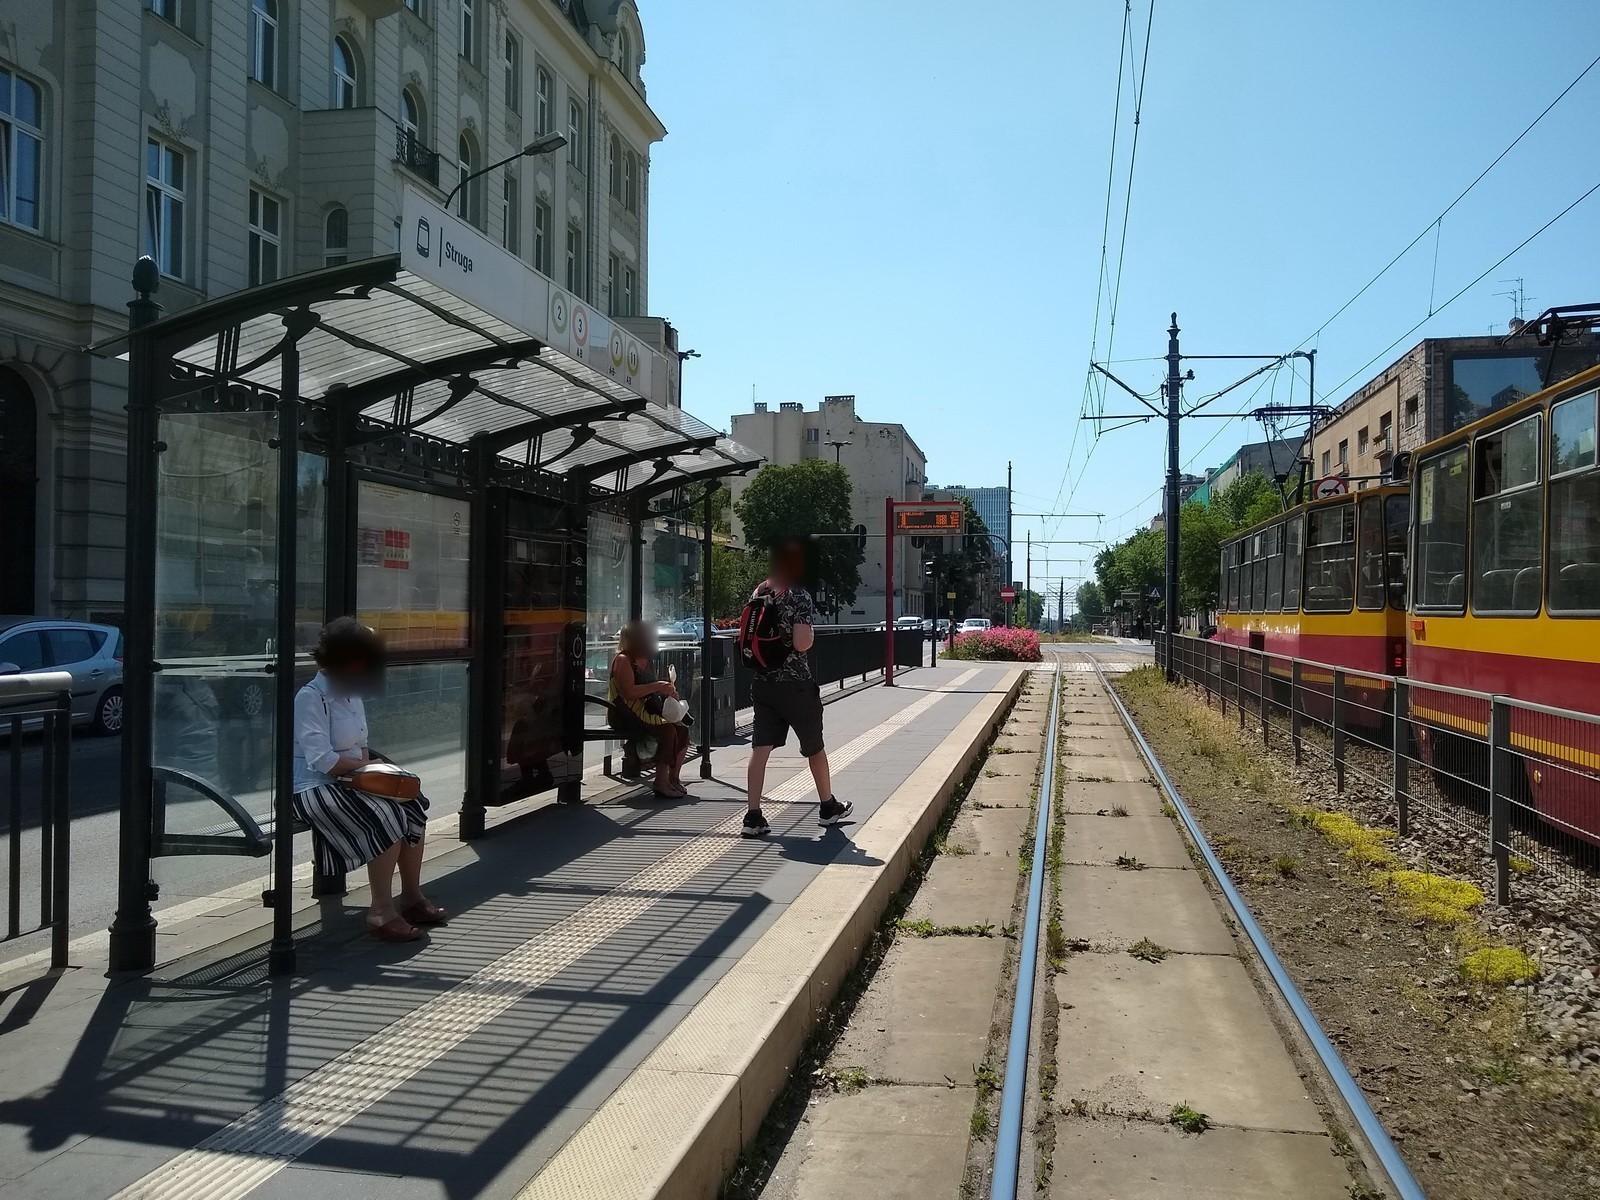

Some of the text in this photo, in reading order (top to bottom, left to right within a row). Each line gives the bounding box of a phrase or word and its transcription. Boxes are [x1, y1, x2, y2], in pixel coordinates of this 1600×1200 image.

[445, 241, 473, 273] Struga
[557, 305, 562, 321] 2
[578, 318, 583, 333] 3
[630, 352, 636, 366] 11
